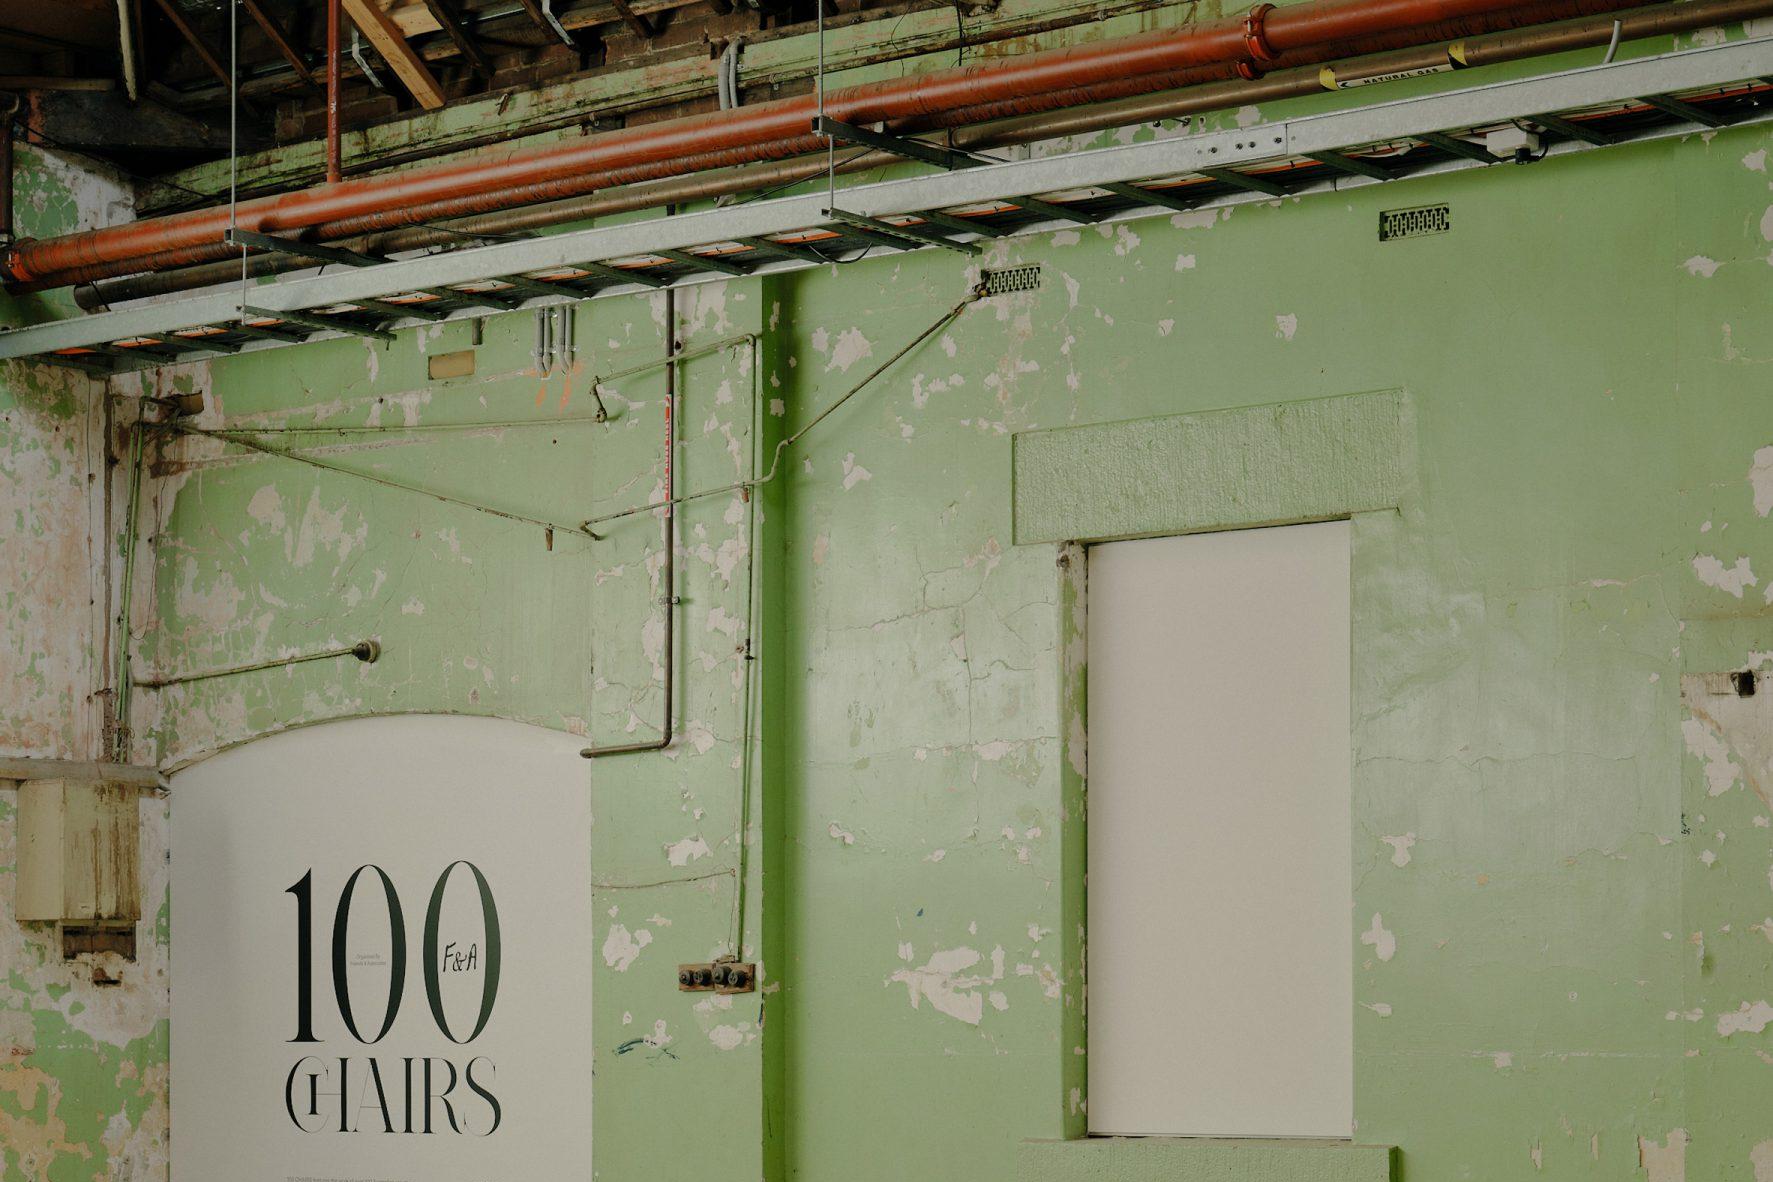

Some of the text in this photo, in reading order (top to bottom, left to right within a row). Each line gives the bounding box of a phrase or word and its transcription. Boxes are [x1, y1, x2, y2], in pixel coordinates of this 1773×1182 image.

[1363, 68, 1439, 84] NATURAL GAS
[285, 860, 501, 1044] 100
[443, 942, 477, 972] F&A
[285, 1056, 501, 1136] CHAIRS
